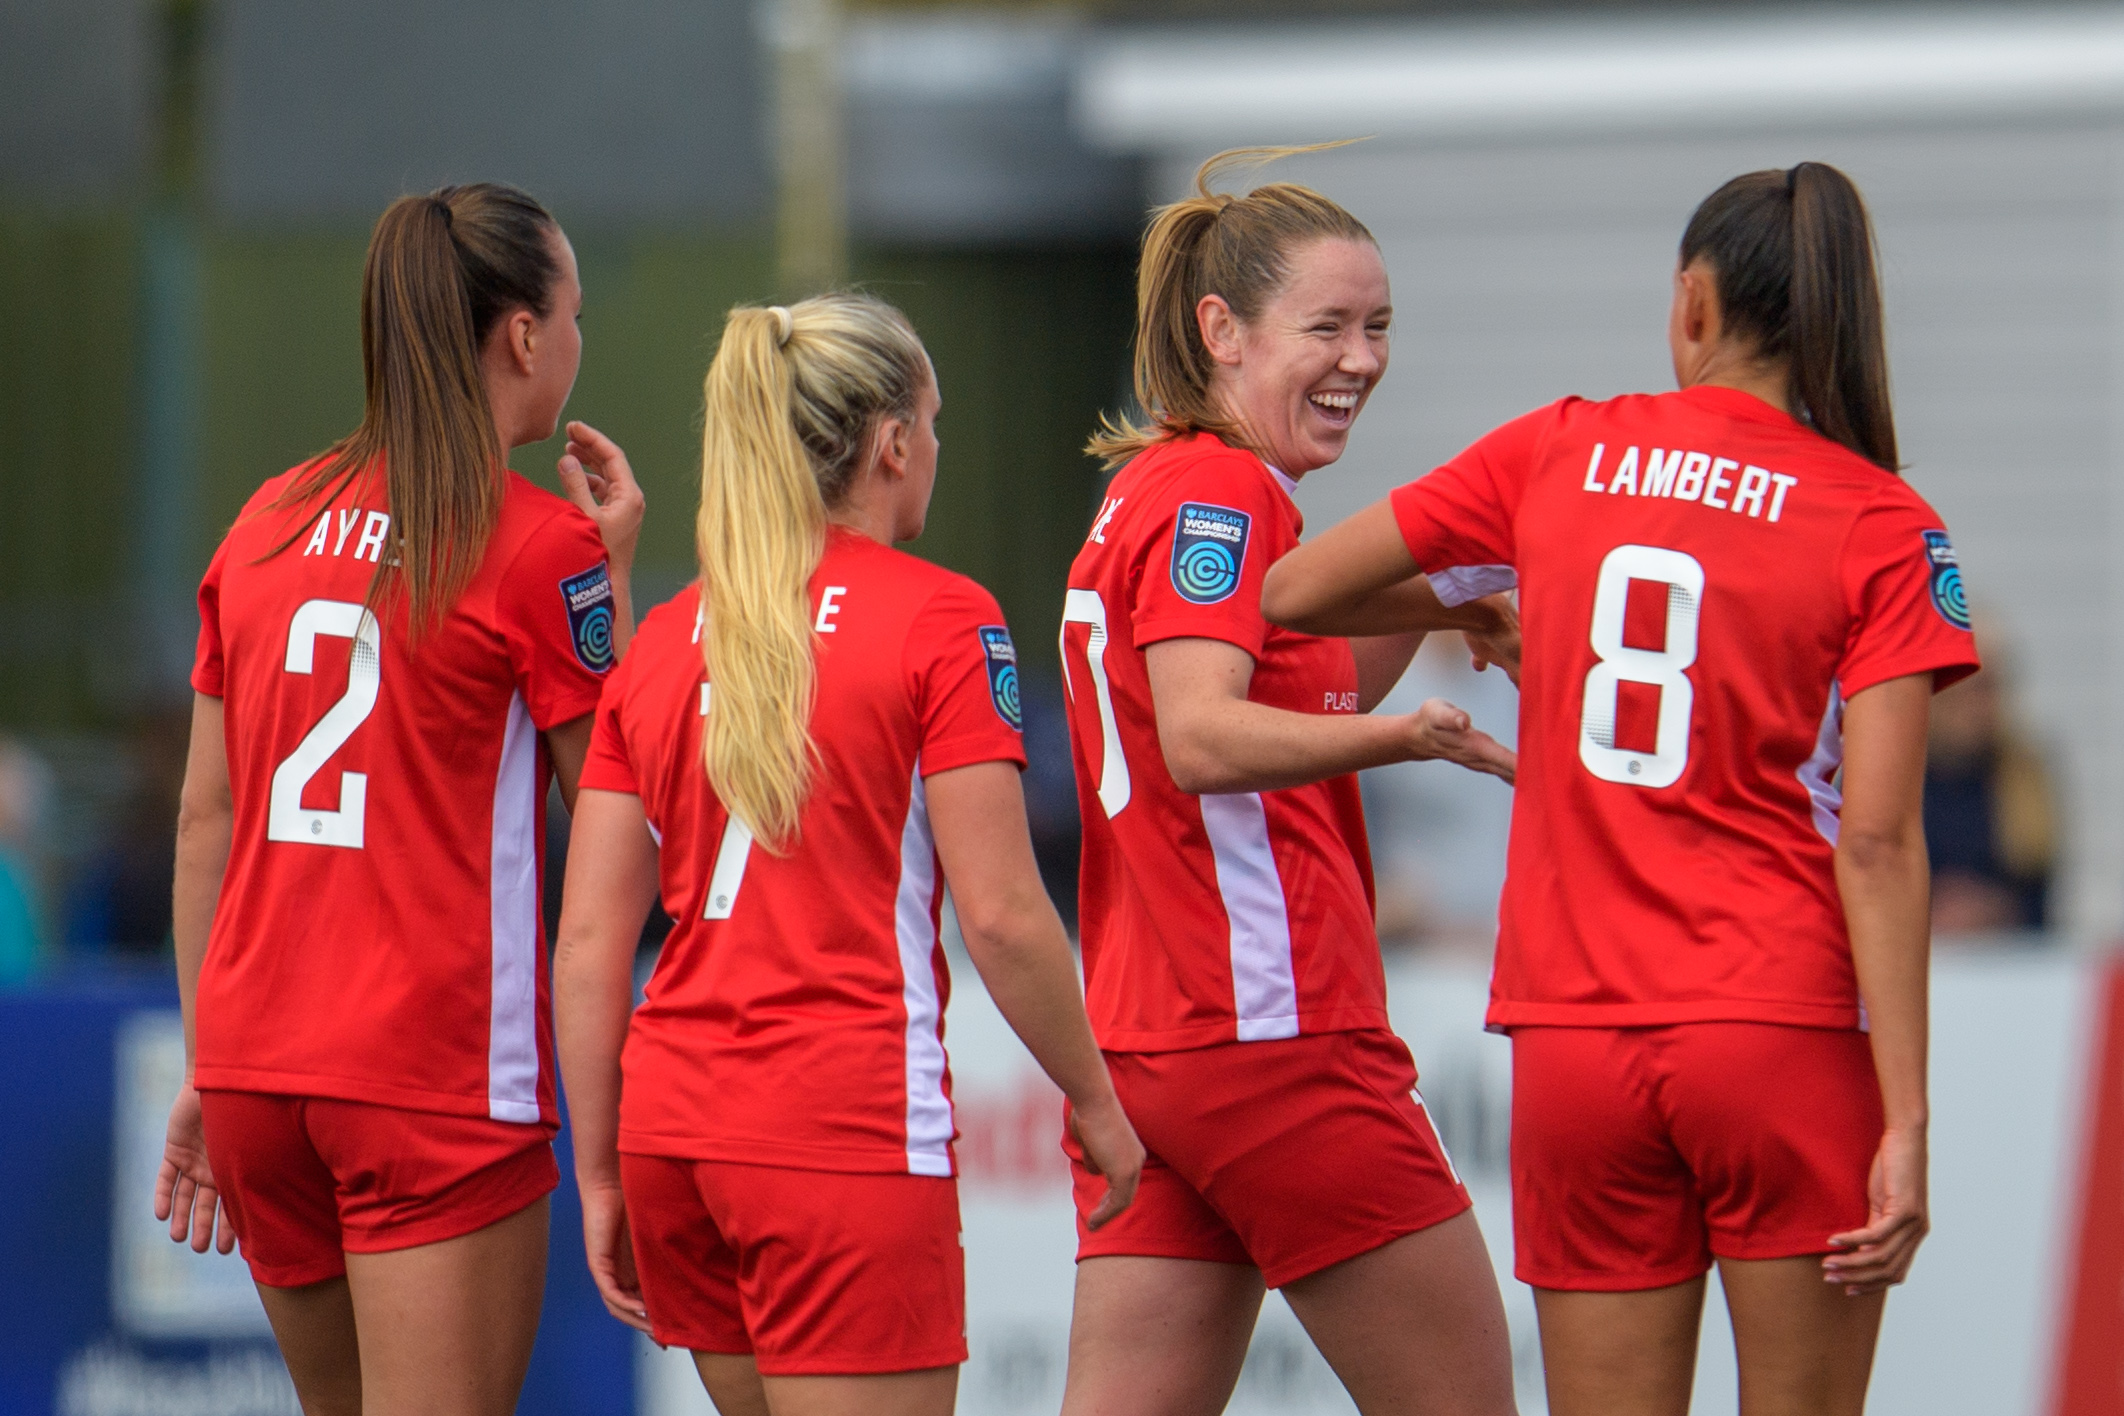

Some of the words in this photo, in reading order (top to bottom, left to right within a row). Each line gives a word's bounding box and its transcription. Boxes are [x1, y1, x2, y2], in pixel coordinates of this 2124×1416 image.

[1583, 443, 1798, 523] LAMBERT
[303, 508, 405, 567] AYR
[1185, 518, 1242, 536] WOMEN'S
[1198, 510, 1244, 527] BARCLAYS
[1579, 544, 1704, 789] 8
[268, 599, 381, 849] 2
